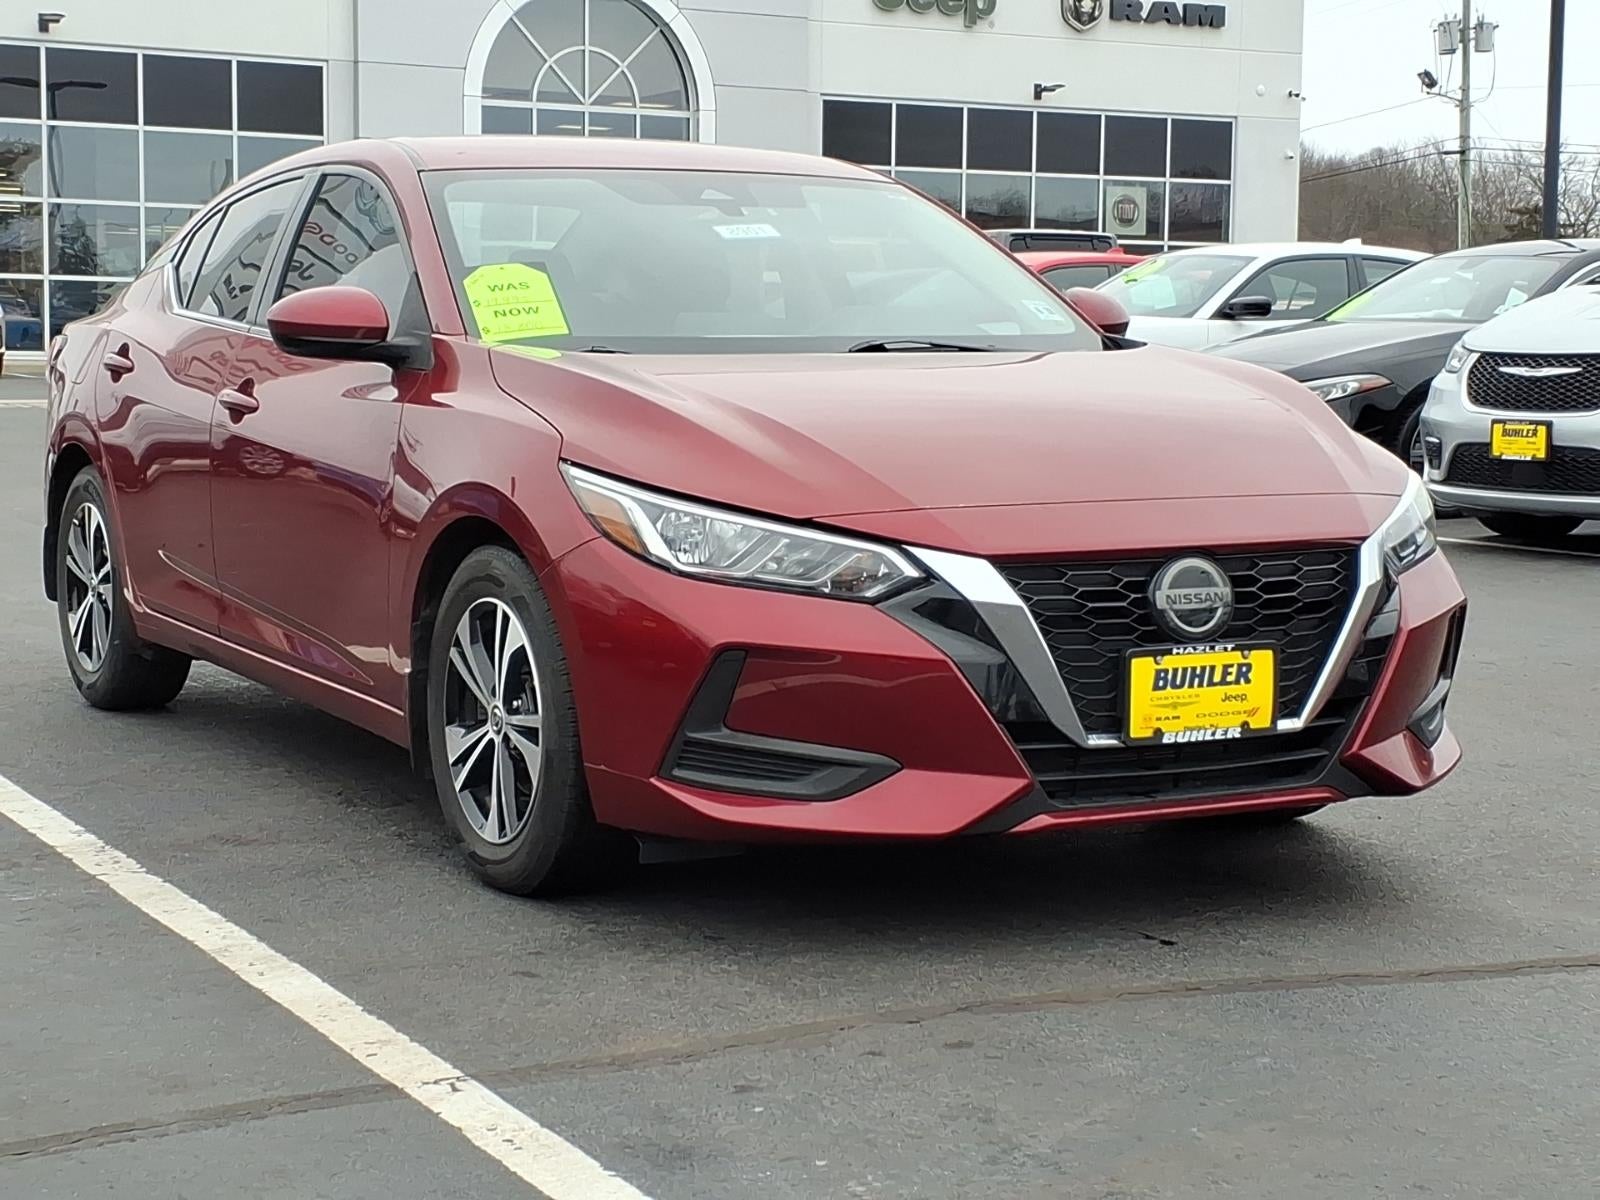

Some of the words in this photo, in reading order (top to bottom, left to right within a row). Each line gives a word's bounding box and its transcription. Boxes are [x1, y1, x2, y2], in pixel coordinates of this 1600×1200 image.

[1110, 0, 1227, 28] RAM
[488, 281, 530, 292] WAS
[493, 306, 540, 318] NOW
[1501, 428, 1538, 438] BUHLER
[1165, 591, 1225, 606] NISSAN
[1172, 644, 1235, 655] HAZLET
[1152, 662, 1253, 692] BUHLER
[1221, 692, 1248, 703] Jeep
[1196, 709, 1249, 718] DODGE
[1162, 727, 1242, 744] BUHLER
